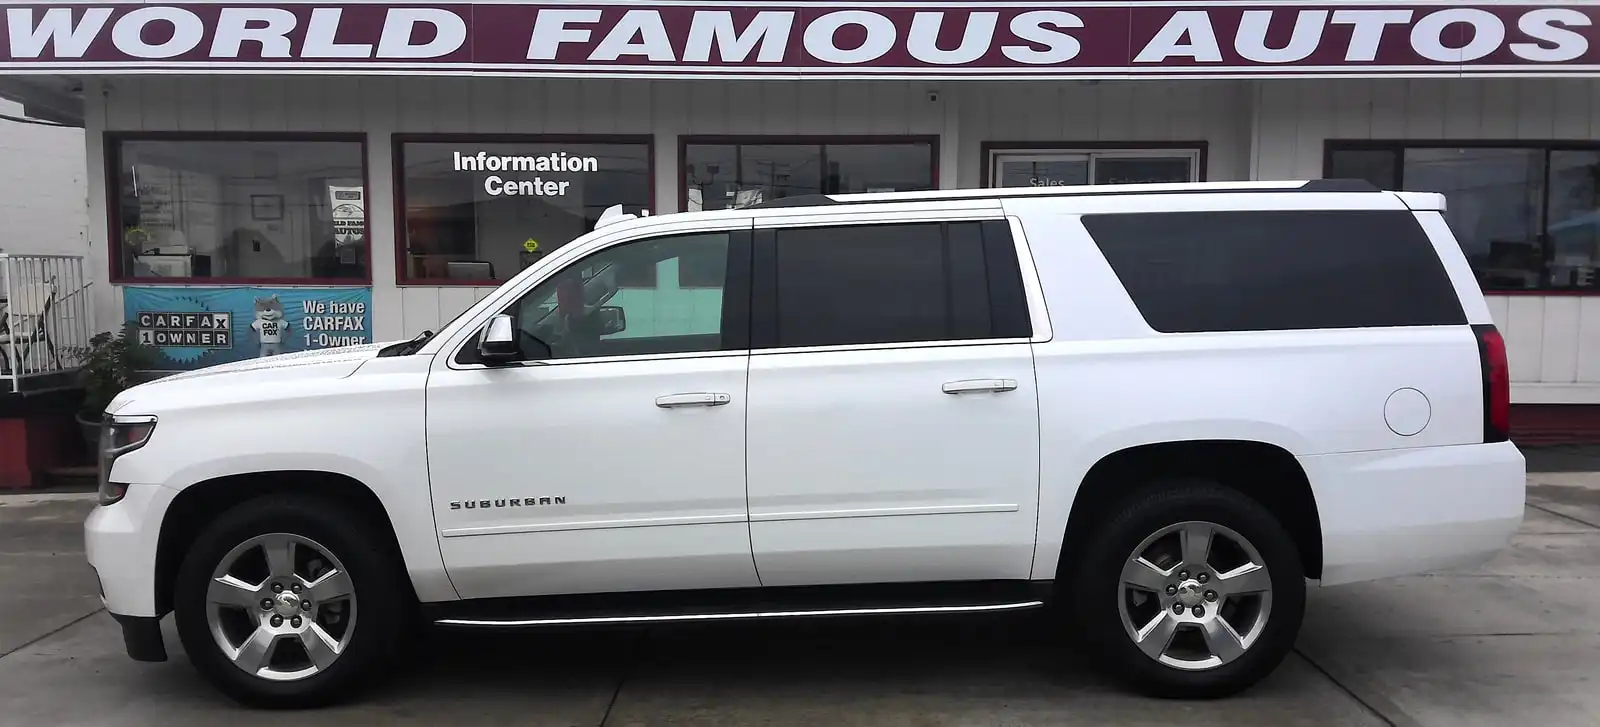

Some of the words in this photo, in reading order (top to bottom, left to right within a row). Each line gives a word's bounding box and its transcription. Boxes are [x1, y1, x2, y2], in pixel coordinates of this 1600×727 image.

[5, 6, 467, 59] WORLD
[526, 8, 1081, 65] FAMOUS
[1132, 7, 1592, 63] AUTOS
[453, 151, 598, 171] Information
[484, 175, 570, 196] Center
[303, 300, 328, 314] We
[329, 300, 365, 314] have
[140, 314, 228, 329] CARFAX
[303, 316, 365, 331] CARFAX
[303, 333, 366, 347] 1-Owner
[450, 496, 566, 510] SUBURBAN
